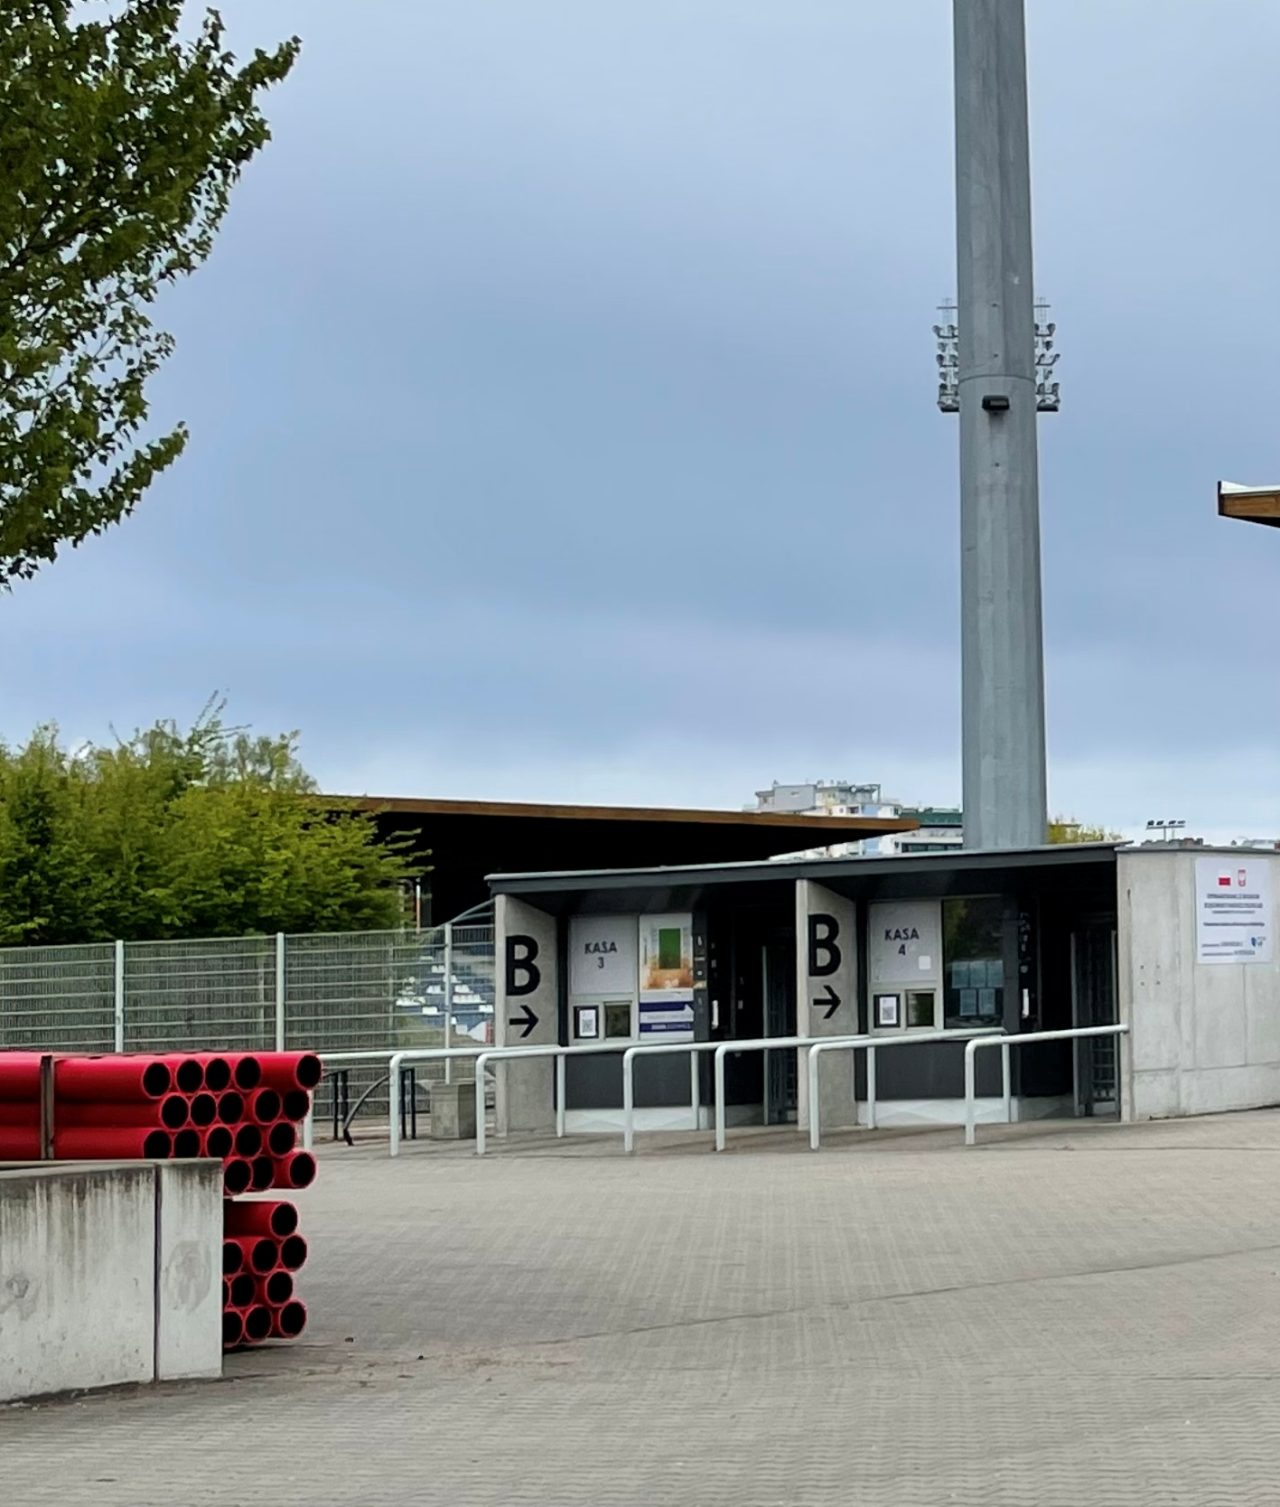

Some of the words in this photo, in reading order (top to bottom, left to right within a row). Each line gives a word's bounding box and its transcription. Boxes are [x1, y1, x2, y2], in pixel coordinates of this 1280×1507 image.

[884, 928, 919, 941] KASA
[584, 941, 617, 954] KASA
[807, 913, 841, 977] B
[898, 943, 906, 956] 4
[505, 934, 541, 996] B
[597, 956, 604, 969] 3
